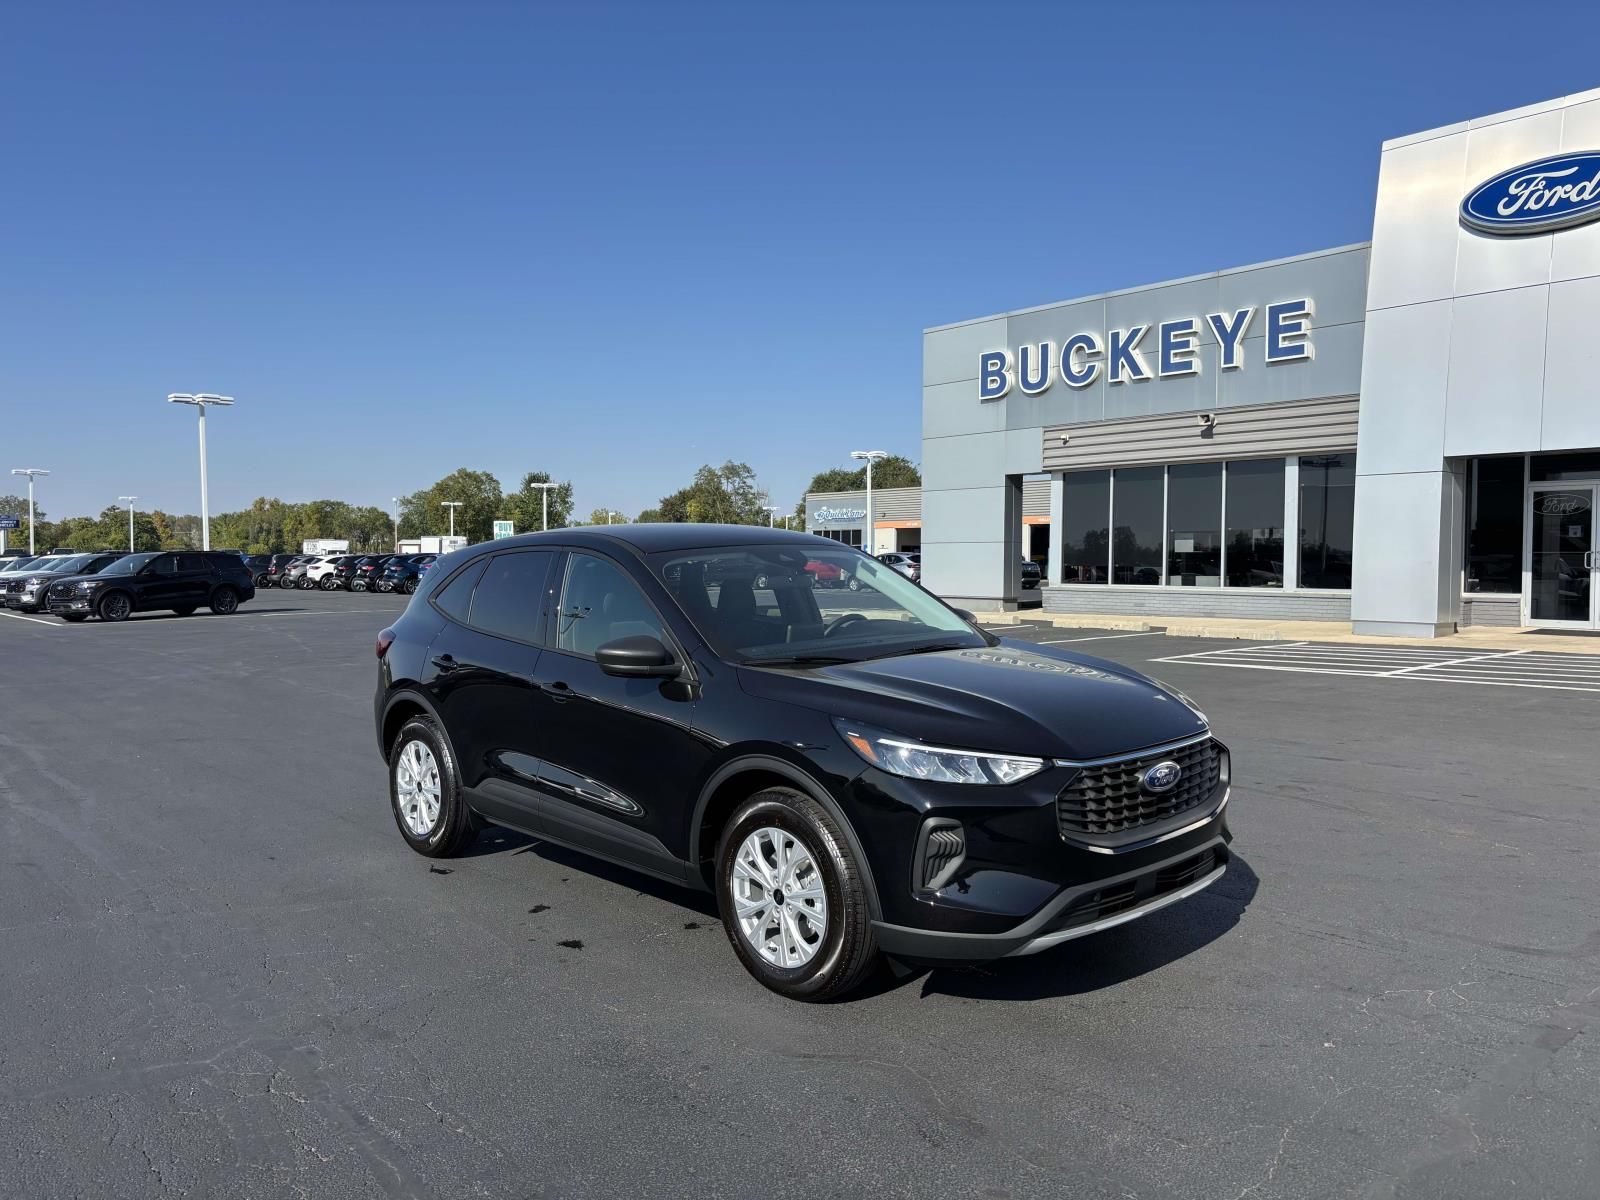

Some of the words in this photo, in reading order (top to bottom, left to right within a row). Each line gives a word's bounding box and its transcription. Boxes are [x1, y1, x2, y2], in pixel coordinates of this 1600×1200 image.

[1497, 166, 1600, 215] Ford
[978, 298, 1314, 401] BUCKEYE
[1542, 498, 1577, 514] Ford
[1155, 768, 1175, 785] Ford
